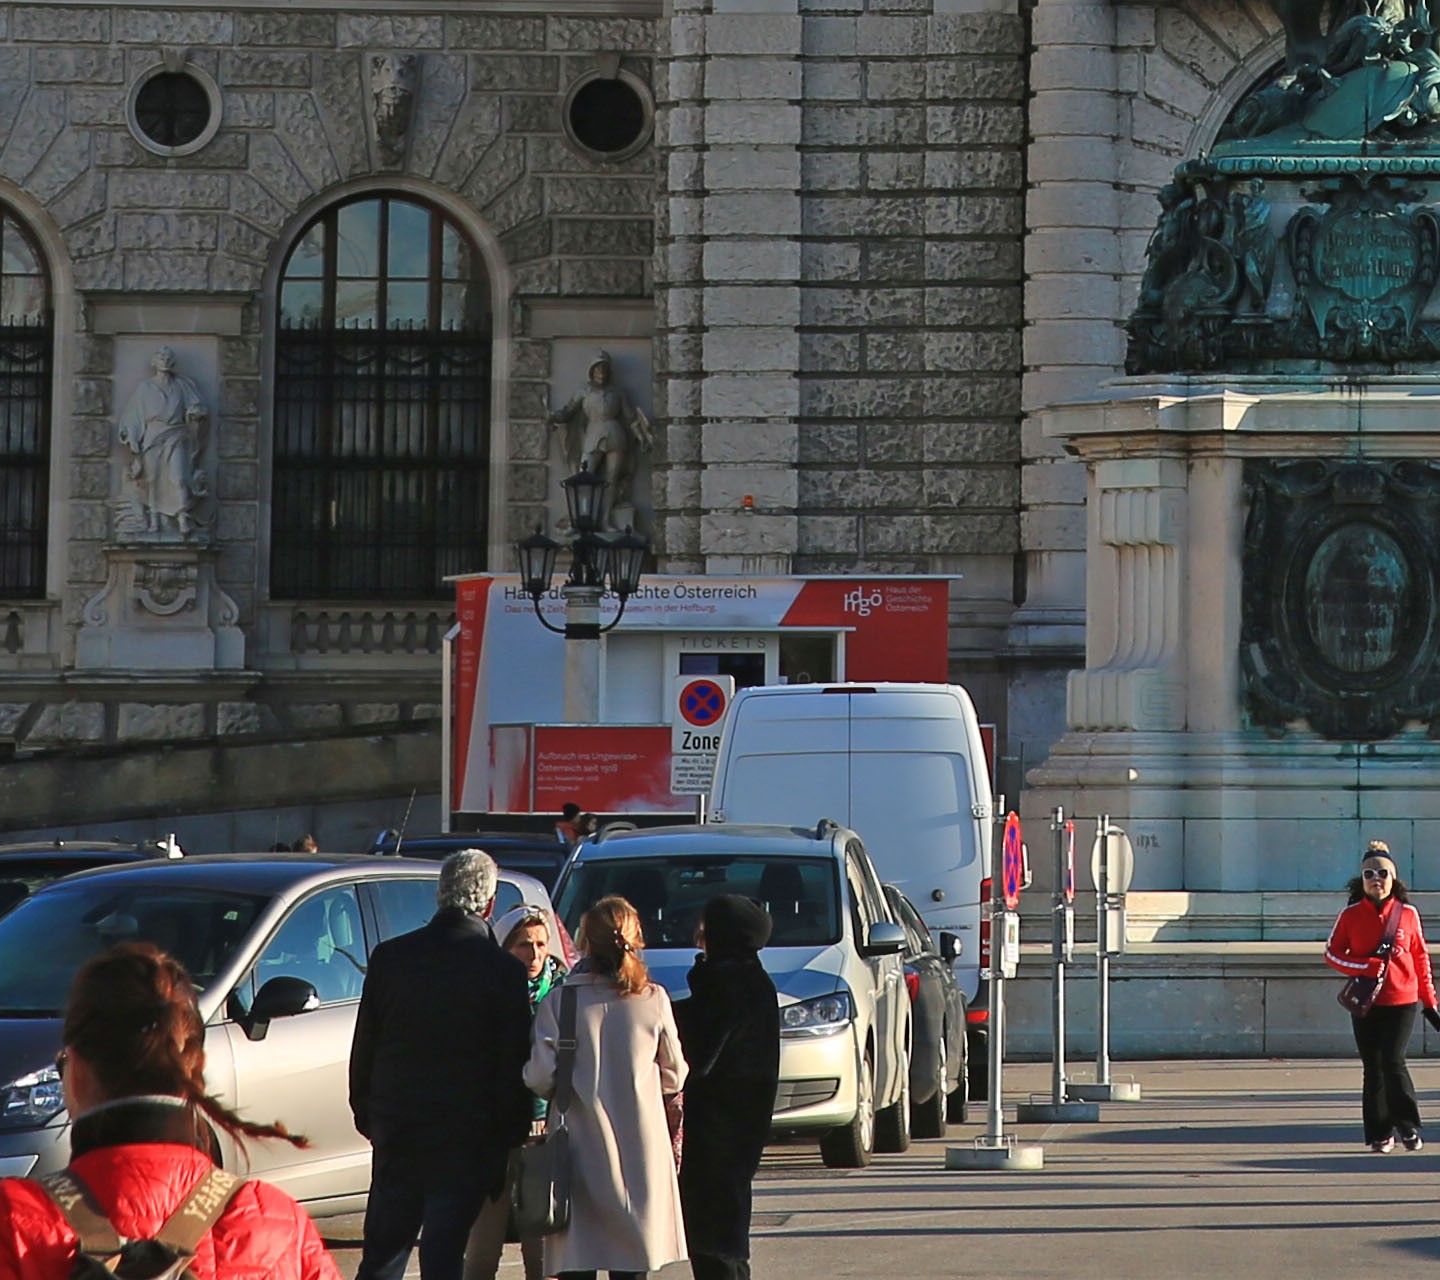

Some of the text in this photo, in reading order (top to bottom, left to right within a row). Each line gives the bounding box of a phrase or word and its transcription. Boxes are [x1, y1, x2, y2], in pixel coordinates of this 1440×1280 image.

[674, 582, 757, 600] Österreich
[680, 636, 767, 650] TICKETS
[682, 731, 720, 750] Zone
